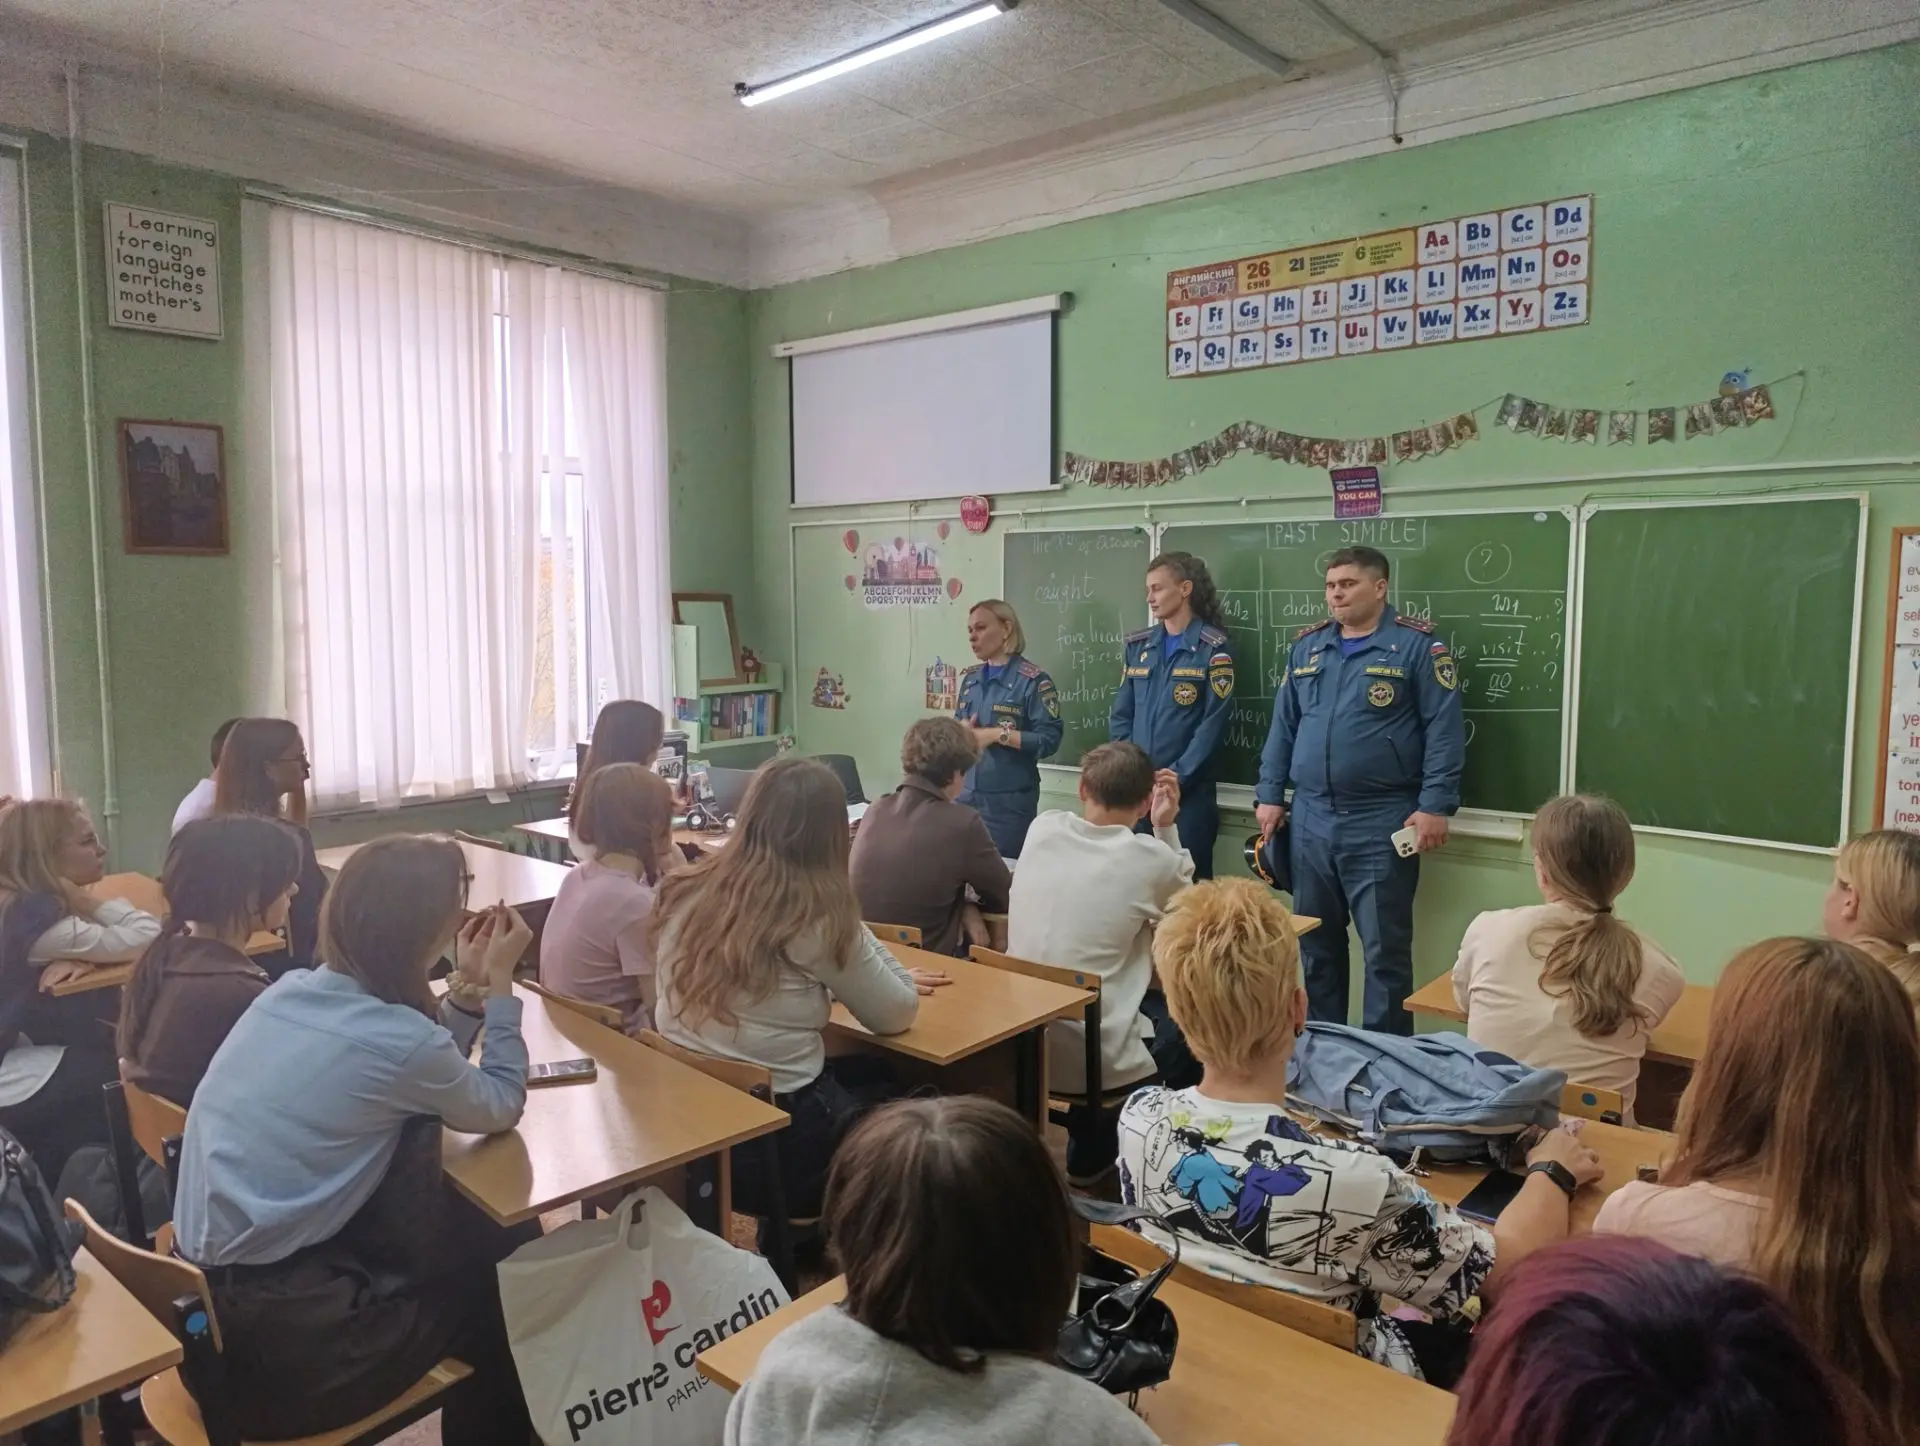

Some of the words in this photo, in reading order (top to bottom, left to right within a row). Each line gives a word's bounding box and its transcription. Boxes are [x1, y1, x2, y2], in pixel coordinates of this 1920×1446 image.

[128, 212, 216, 247] Learning
[1425, 231, 1449, 248] Aa
[1467, 223, 1491, 241] Bb
[1511, 214, 1534, 233] Cc
[1554, 207, 1582, 226] Dd
[118, 231, 193, 261] foreign
[1355, 246, 1366, 260] 6
[116, 248, 207, 279] language
[1173, 265, 1234, 286] АНГЛИЙСКИЙ
[1247, 261, 1270, 280] 26
[1289, 257, 1304, 272] 21
[119, 272, 204, 295] enriches
[1176, 312, 1191, 327] Ee
[1209, 307, 1223, 322] Ff
[1239, 301, 1259, 318] Gg
[1274, 296, 1295, 312] Hh
[1312, 290, 1328, 306] Ii
[1348, 283, 1366, 302] Jj
[1384, 277, 1408, 295] Kk
[1428, 271, 1445, 288] Ll
[1461, 263, 1496, 283] Mm
[1508, 256, 1535, 275] Nn
[1552, 250, 1581, 268] Oo
[120, 290, 202, 312] mother's
[122, 309, 158, 323] one
[1175, 347, 1192, 364] Pp
[1204, 342, 1225, 360] Qq
[1240, 338, 1258, 354] Rr
[1275, 333, 1293, 349] Ss
[1310, 327, 1328, 344] Tt
[1345, 322, 1368, 339] Uu
[1383, 316, 1407, 334] Vv
[1419, 309, 1453, 328] Ww
[1464, 304, 1491, 322] Xx
[1507, 298, 1534, 318] Yy
[1554, 291, 1578, 310] Zz
[1338, 492, 1357, 500] YOU
[1358, 490, 1377, 500] CAN
[1275, 520, 1320, 545] PAST
[1341, 519, 1417, 543] SIMPLE
[864, 586, 942, 596] ABCDEFGHIJKLMN
[865, 596, 938, 605] OPQRSTUVWXYZ
[1406, 596, 1431, 625] Did
[1482, 629, 1528, 656] visit
[565, 1362, 670, 1443] pierre
[674, 1288, 780, 1369] cardin
[666, 1373, 711, 1412] PARIS
